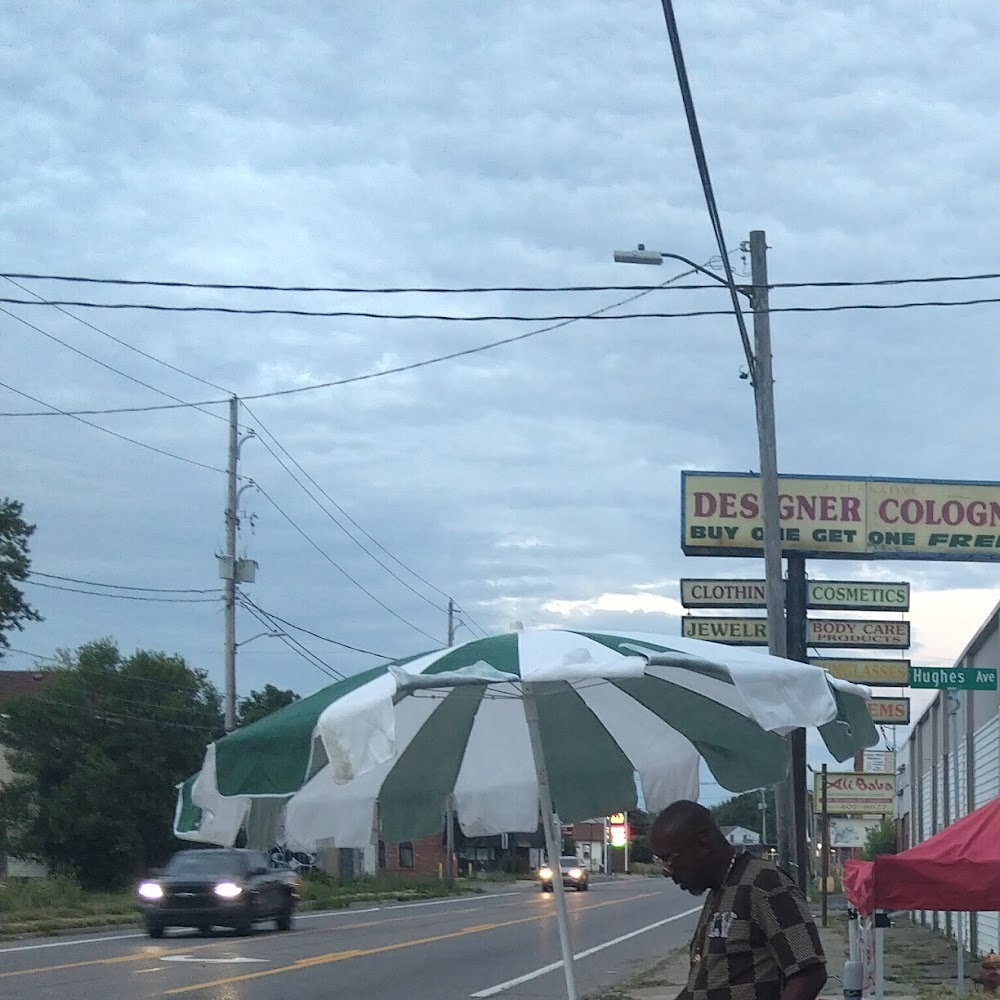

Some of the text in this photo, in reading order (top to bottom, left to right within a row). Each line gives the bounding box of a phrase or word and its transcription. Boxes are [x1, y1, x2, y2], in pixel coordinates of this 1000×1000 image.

[693, 492, 862, 522] DESGNER
[690, 526, 739, 540] BUY
[812, 529, 857, 543] GET
[868, 531, 915, 546] ONE
[691, 585, 765, 600] CLOTHIN
[812, 586, 906, 603] COSMETICS
[687, 622, 767, 638] JEWELR
[813, 623, 906, 636] BODY CARE
[817, 634, 901, 643] PRODUCTS
[913, 668, 996, 687] Hughes Ave
[868, 703, 905, 718] EMS
[827, 777, 894, 791] Ali Baba
[708, 911, 738, 938] LV
